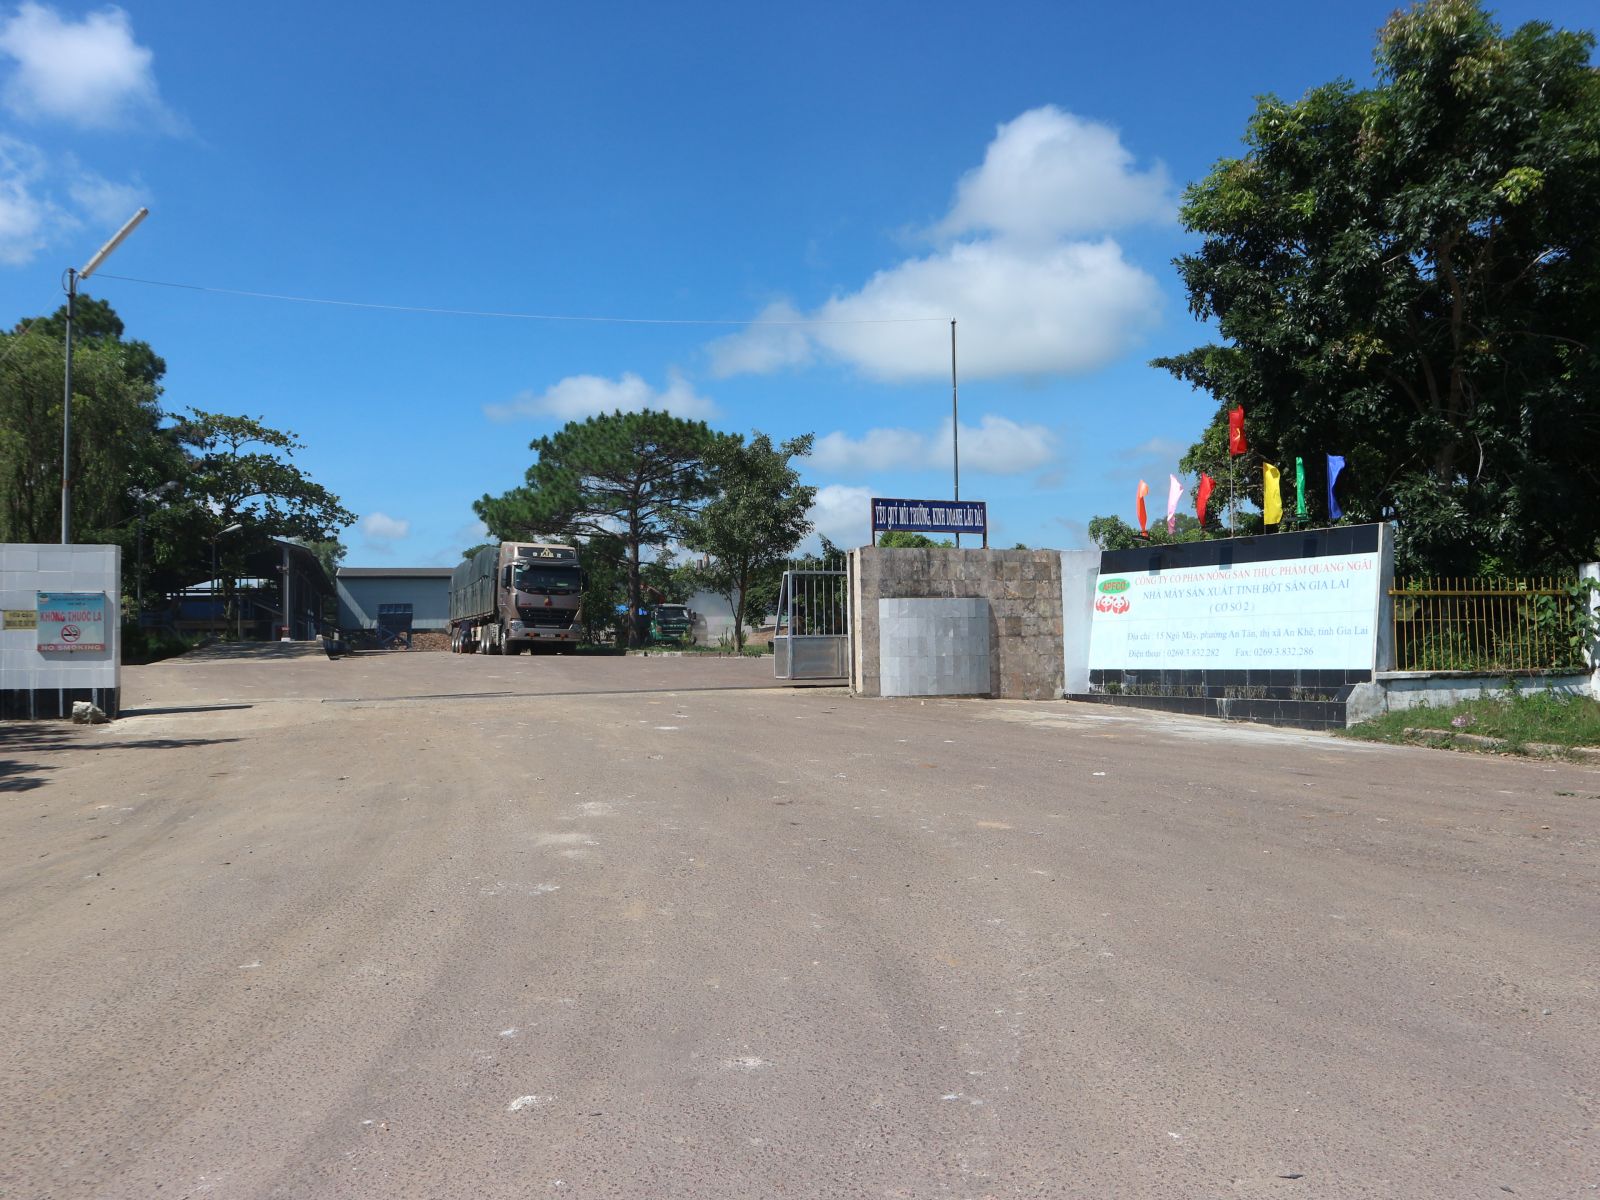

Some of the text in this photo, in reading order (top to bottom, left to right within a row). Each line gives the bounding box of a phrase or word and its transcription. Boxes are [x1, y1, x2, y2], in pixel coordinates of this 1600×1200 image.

[875, 502, 886, 525] YÊU
[899, 502, 909, 525] MÔI
[932, 508, 946, 526] KINH
[946, 508, 963, 526] DOANH
[975, 505, 984, 527] DÀI
[1135, 575, 1157, 586] CÔNG
[1159, 574, 1169, 585] TY
[1206, 569, 1231, 581] NÔNG
[1347, 559, 1372, 571] NGÃI
[1103, 581, 1127, 591] APFCO
[1143, 590, 1162, 600] NHÀ
[1164, 588, 1185, 599] MÁY
[1309, 580, 1328, 591] GIA
[1331, 578, 1350, 589] LAI
[1244, 602, 1249, 611] 2
[1228, 630, 1240, 639] An
[1283, 628, 1295, 637] An
[1336, 626, 1352, 636] Gia
[1354, 625, 1368, 635] Lai
